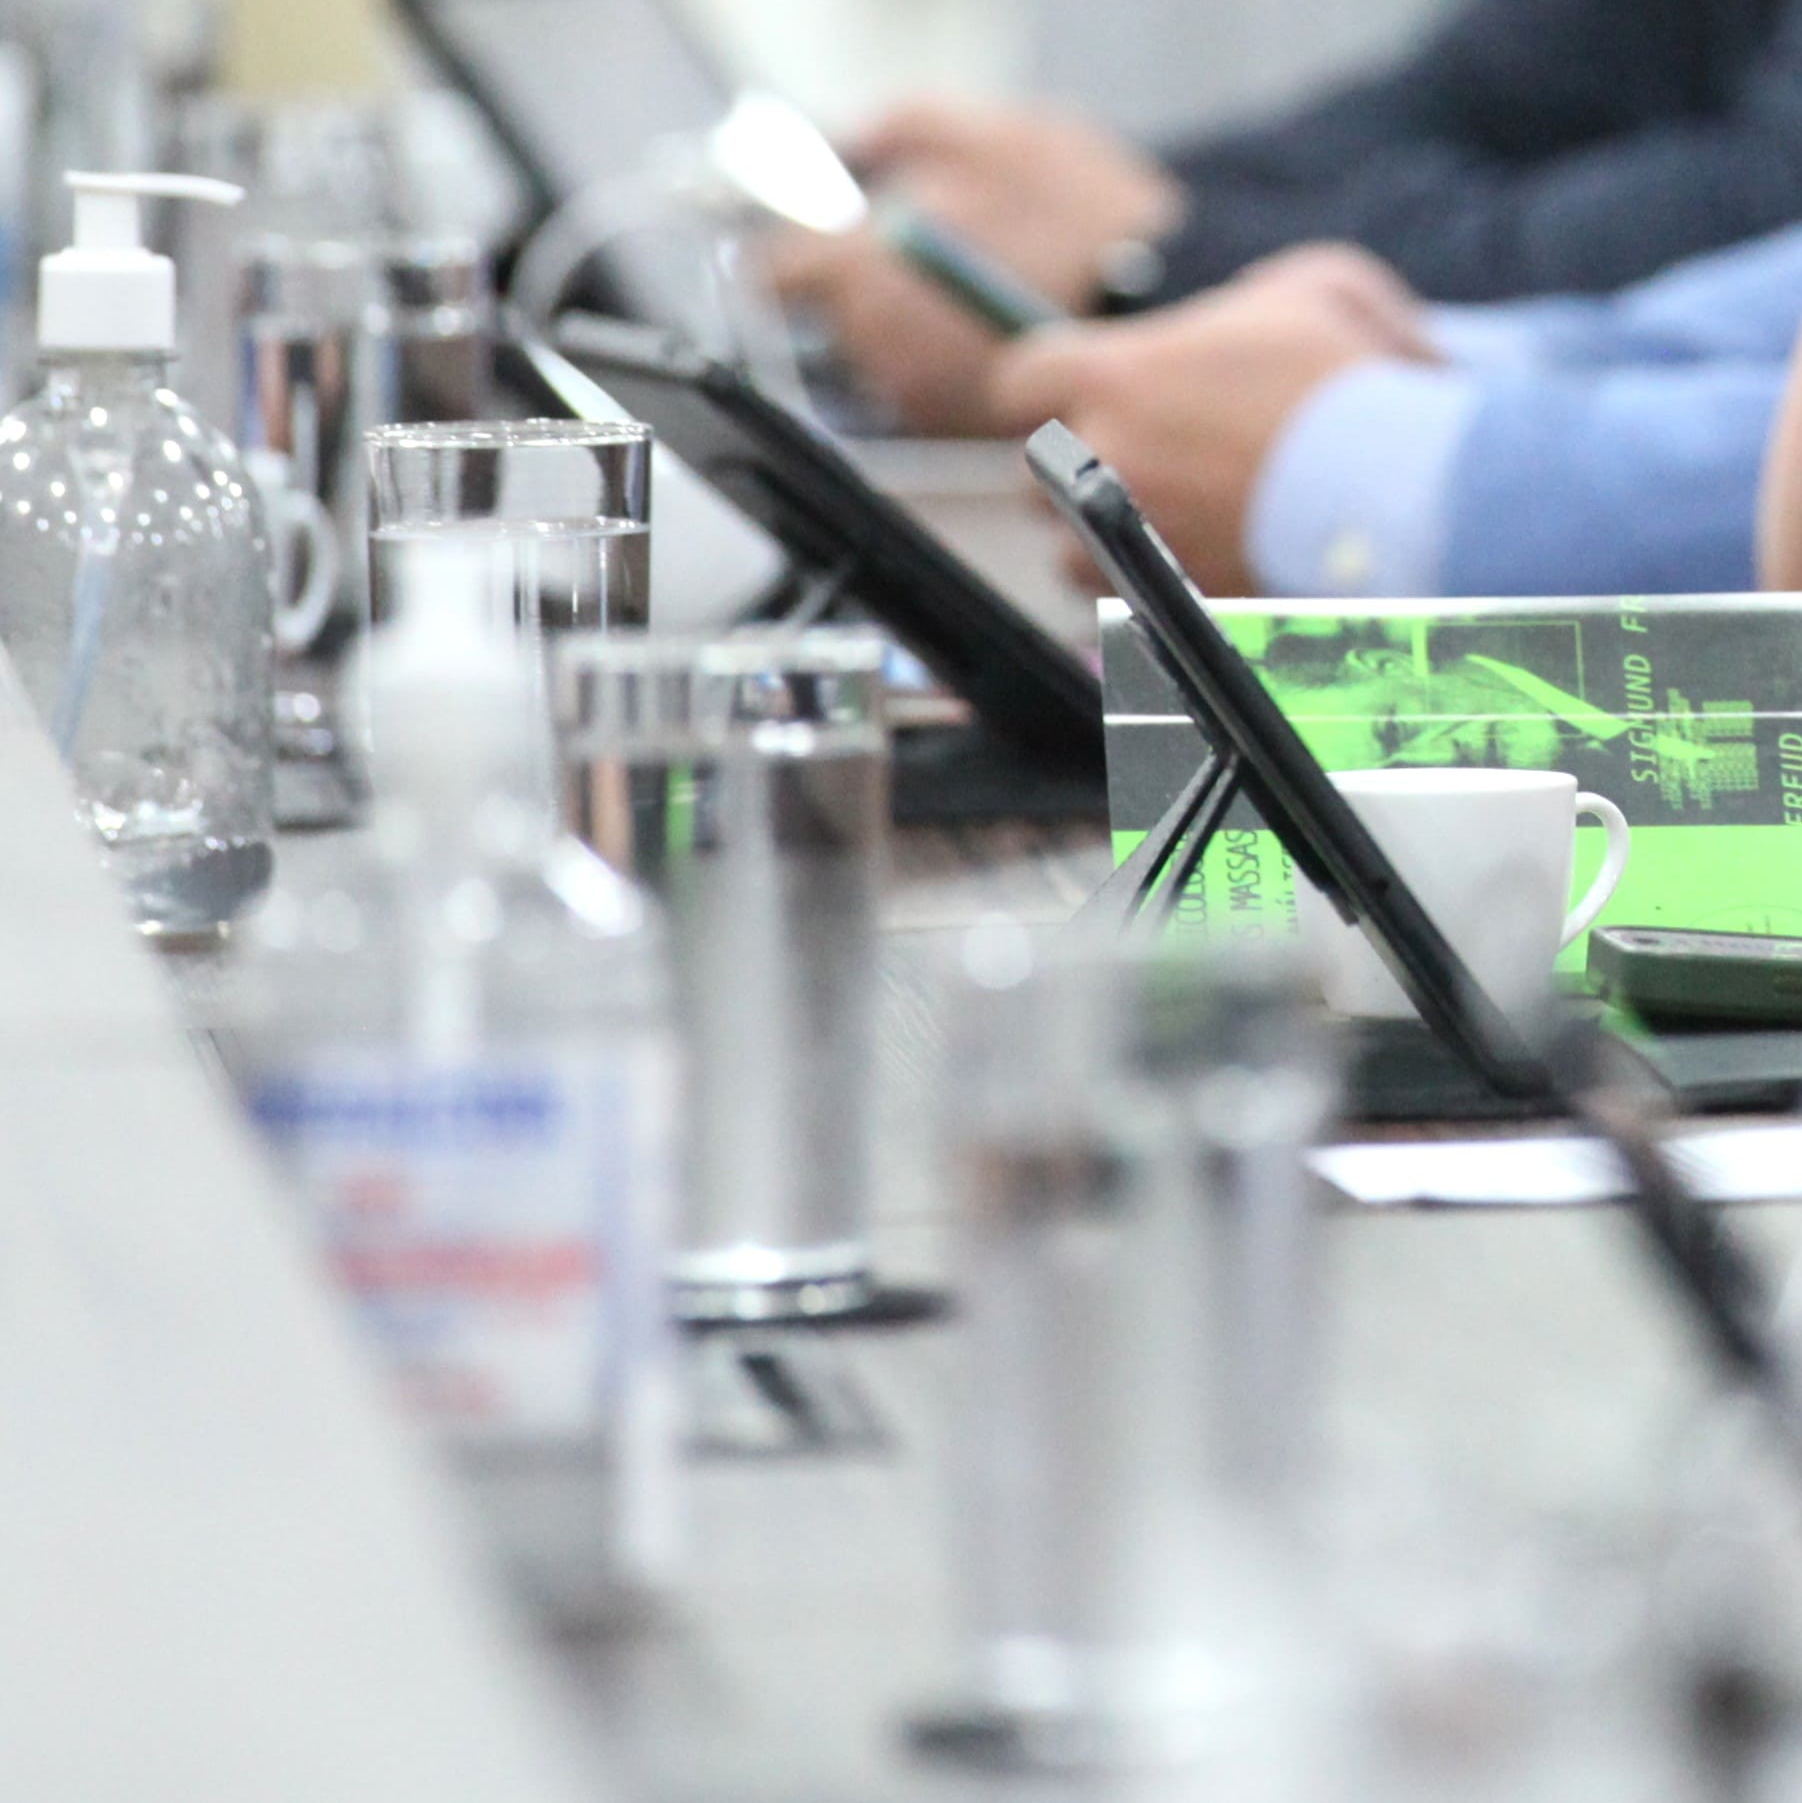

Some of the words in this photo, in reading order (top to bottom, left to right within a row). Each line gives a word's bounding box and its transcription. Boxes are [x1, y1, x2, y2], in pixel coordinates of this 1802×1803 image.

[1619, 595, 1649, 634] FR
[1622, 653, 1660, 784] SIGMUND
[1224, 829, 1263, 912] MASSAS
